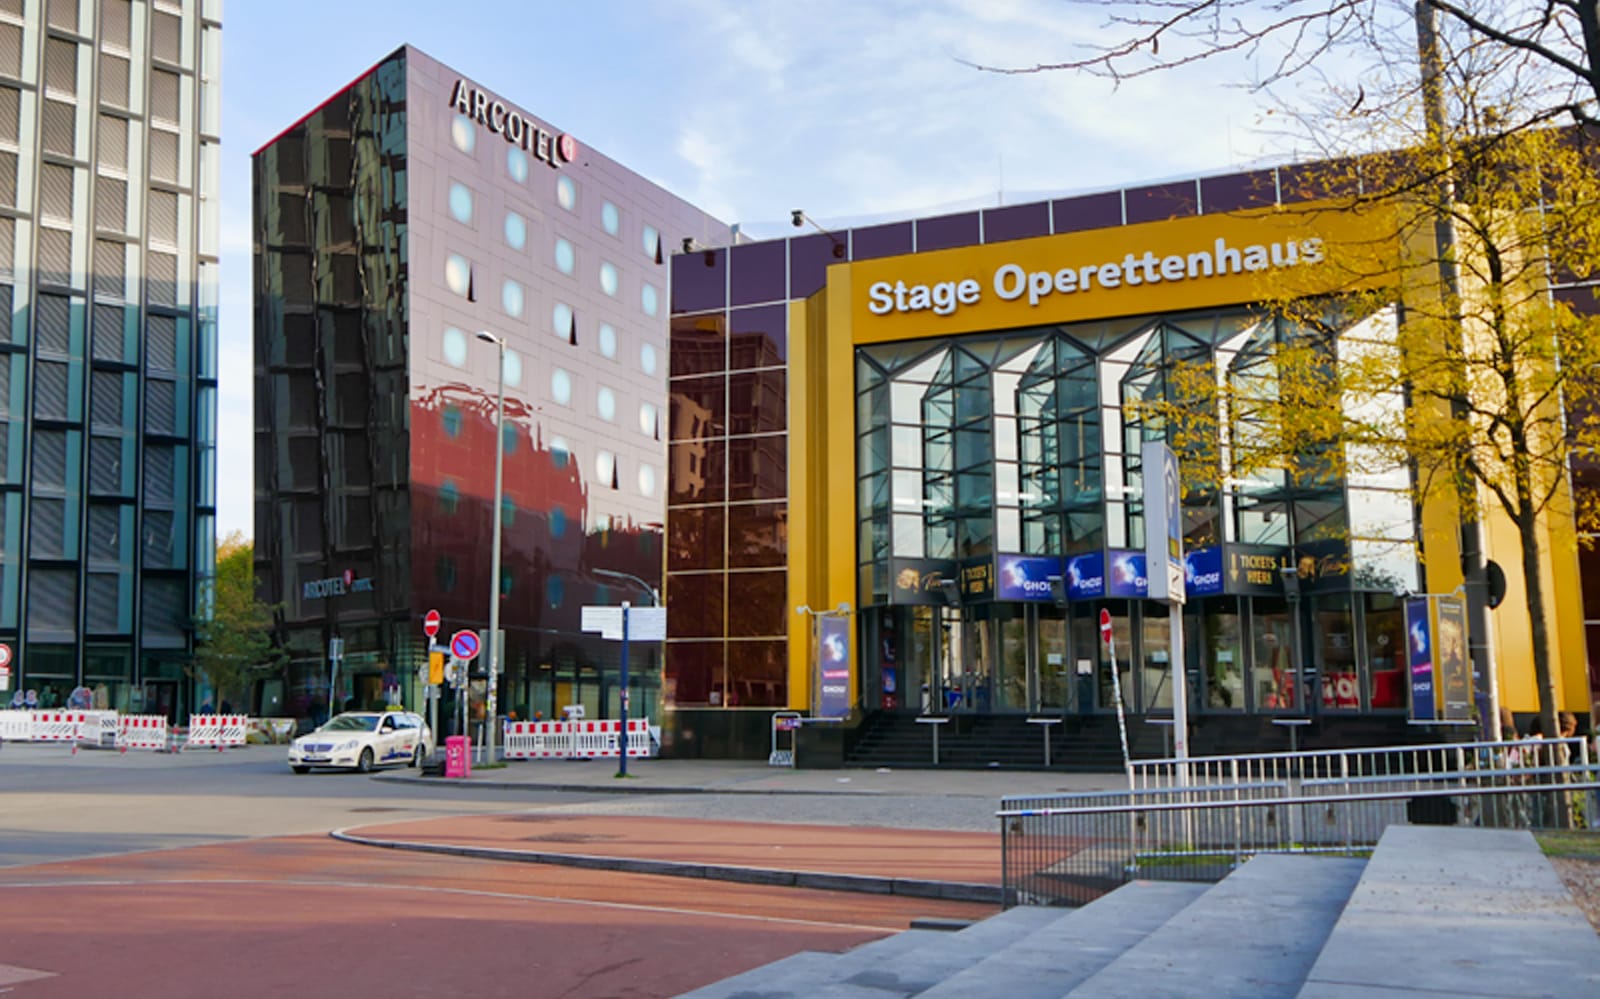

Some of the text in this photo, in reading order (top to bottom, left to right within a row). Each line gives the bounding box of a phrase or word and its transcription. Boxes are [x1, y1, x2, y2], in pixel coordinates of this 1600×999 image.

[449, 79, 563, 169] ARCOTEL
[868, 237, 1326, 315] Stage Operettenhaus
